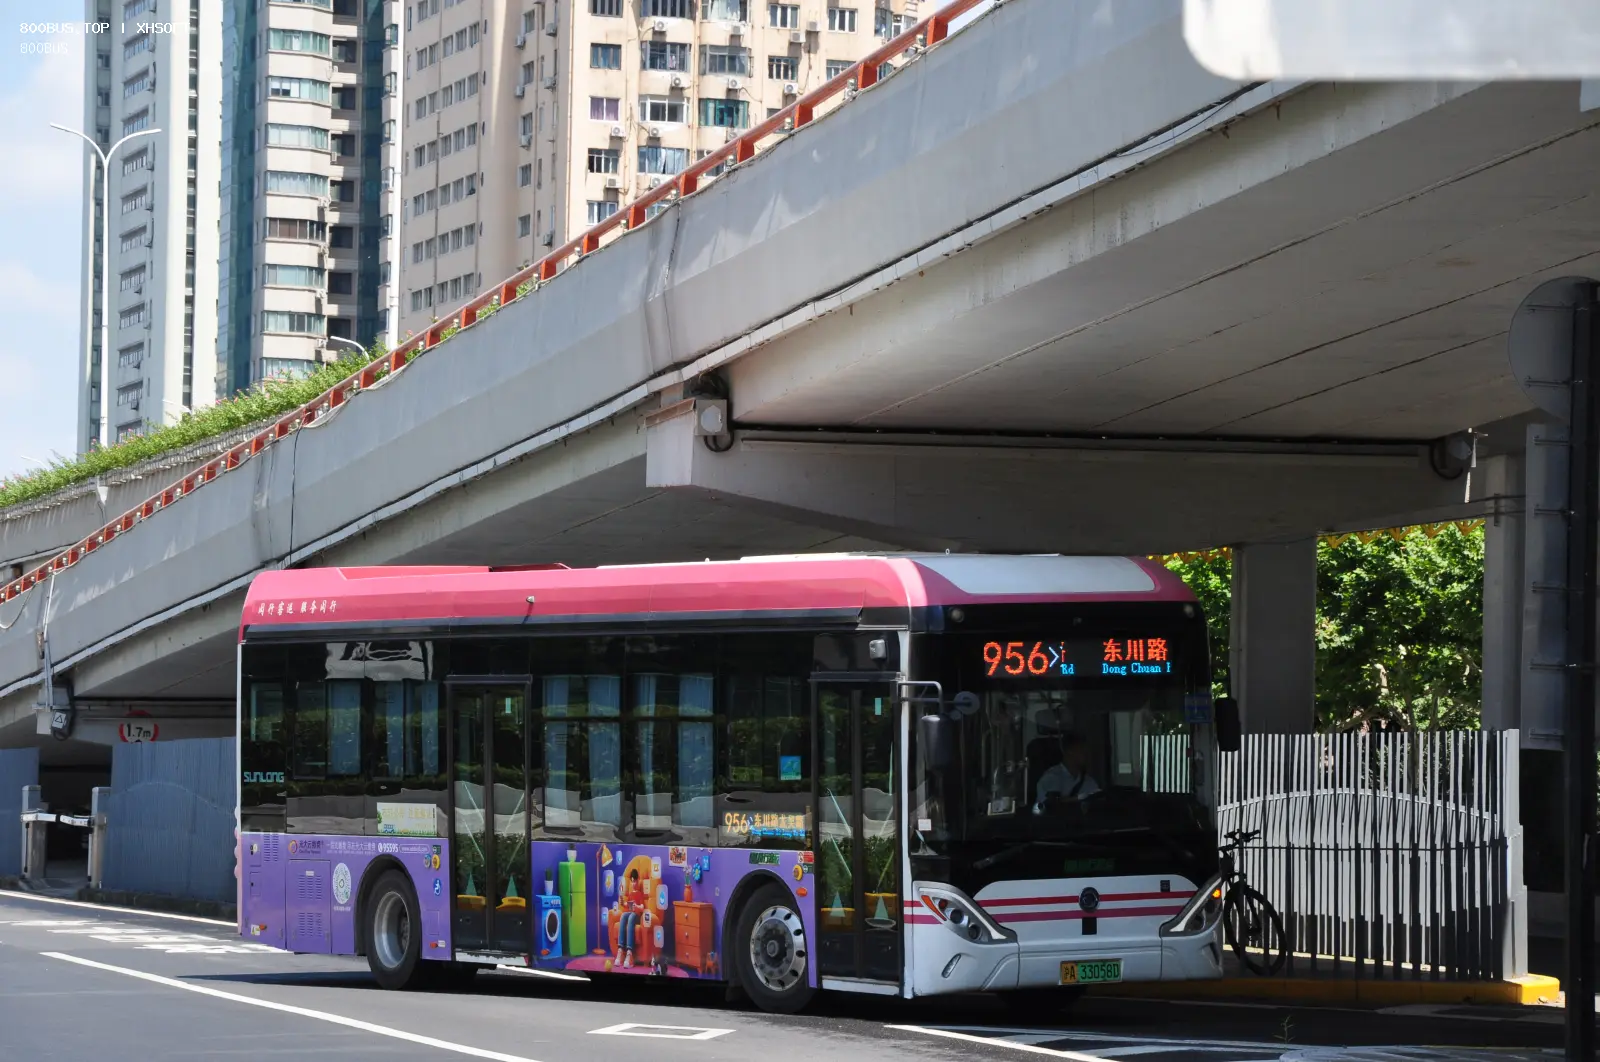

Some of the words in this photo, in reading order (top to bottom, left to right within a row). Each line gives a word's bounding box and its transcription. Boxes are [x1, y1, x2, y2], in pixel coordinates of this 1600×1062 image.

[1103, 637, 1168, 662] 东川路
[983, 641, 1049, 677] 956
[1060, 663, 1075, 675] Rd
[1102, 662, 1127, 675] Dong
[1131, 662, 1162, 673] Chuan
[127, 723, 151, 737] 1.7m
[243, 771, 285, 783] SUNLONG
[725, 813, 748, 833] 956
[383, 843, 399, 853] 95595
